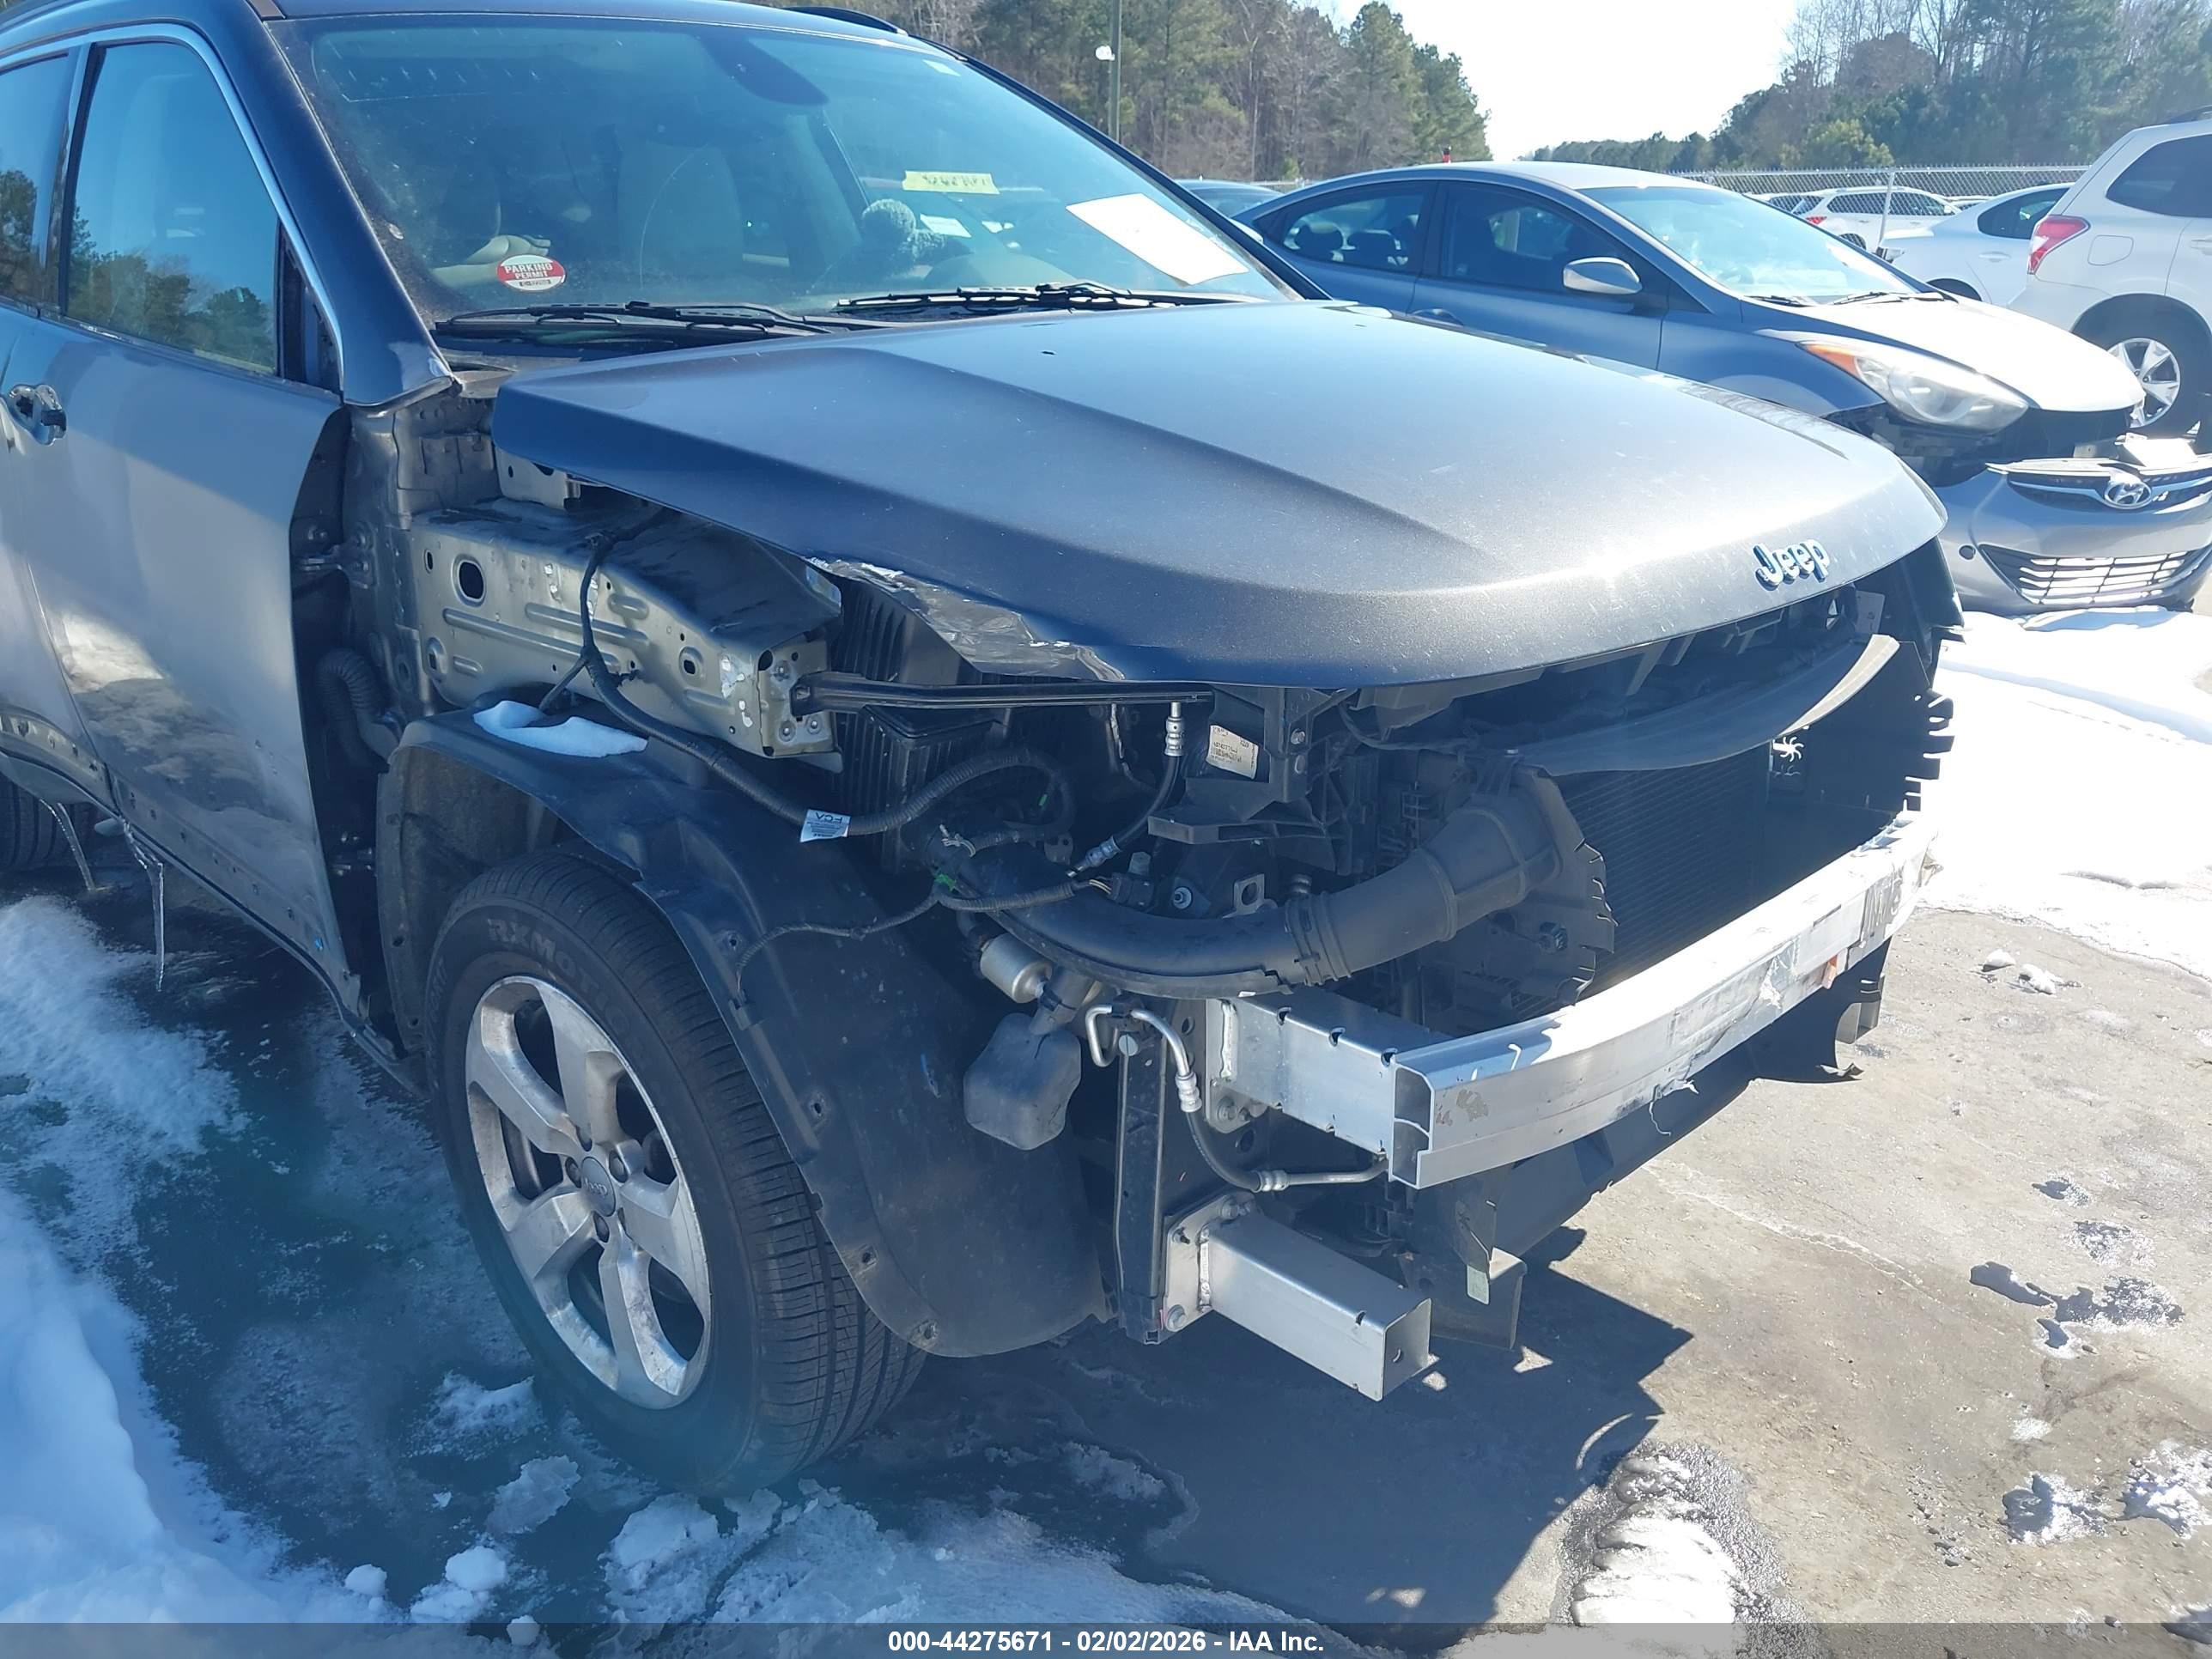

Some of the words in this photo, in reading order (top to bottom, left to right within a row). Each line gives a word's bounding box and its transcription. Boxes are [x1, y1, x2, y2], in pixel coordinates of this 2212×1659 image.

[503, 263, 554, 274] PARKING
[515, 270, 549, 279] PERMIT
[1753, 538, 1830, 592] Jeep
[816, 811, 843, 823] FCA
